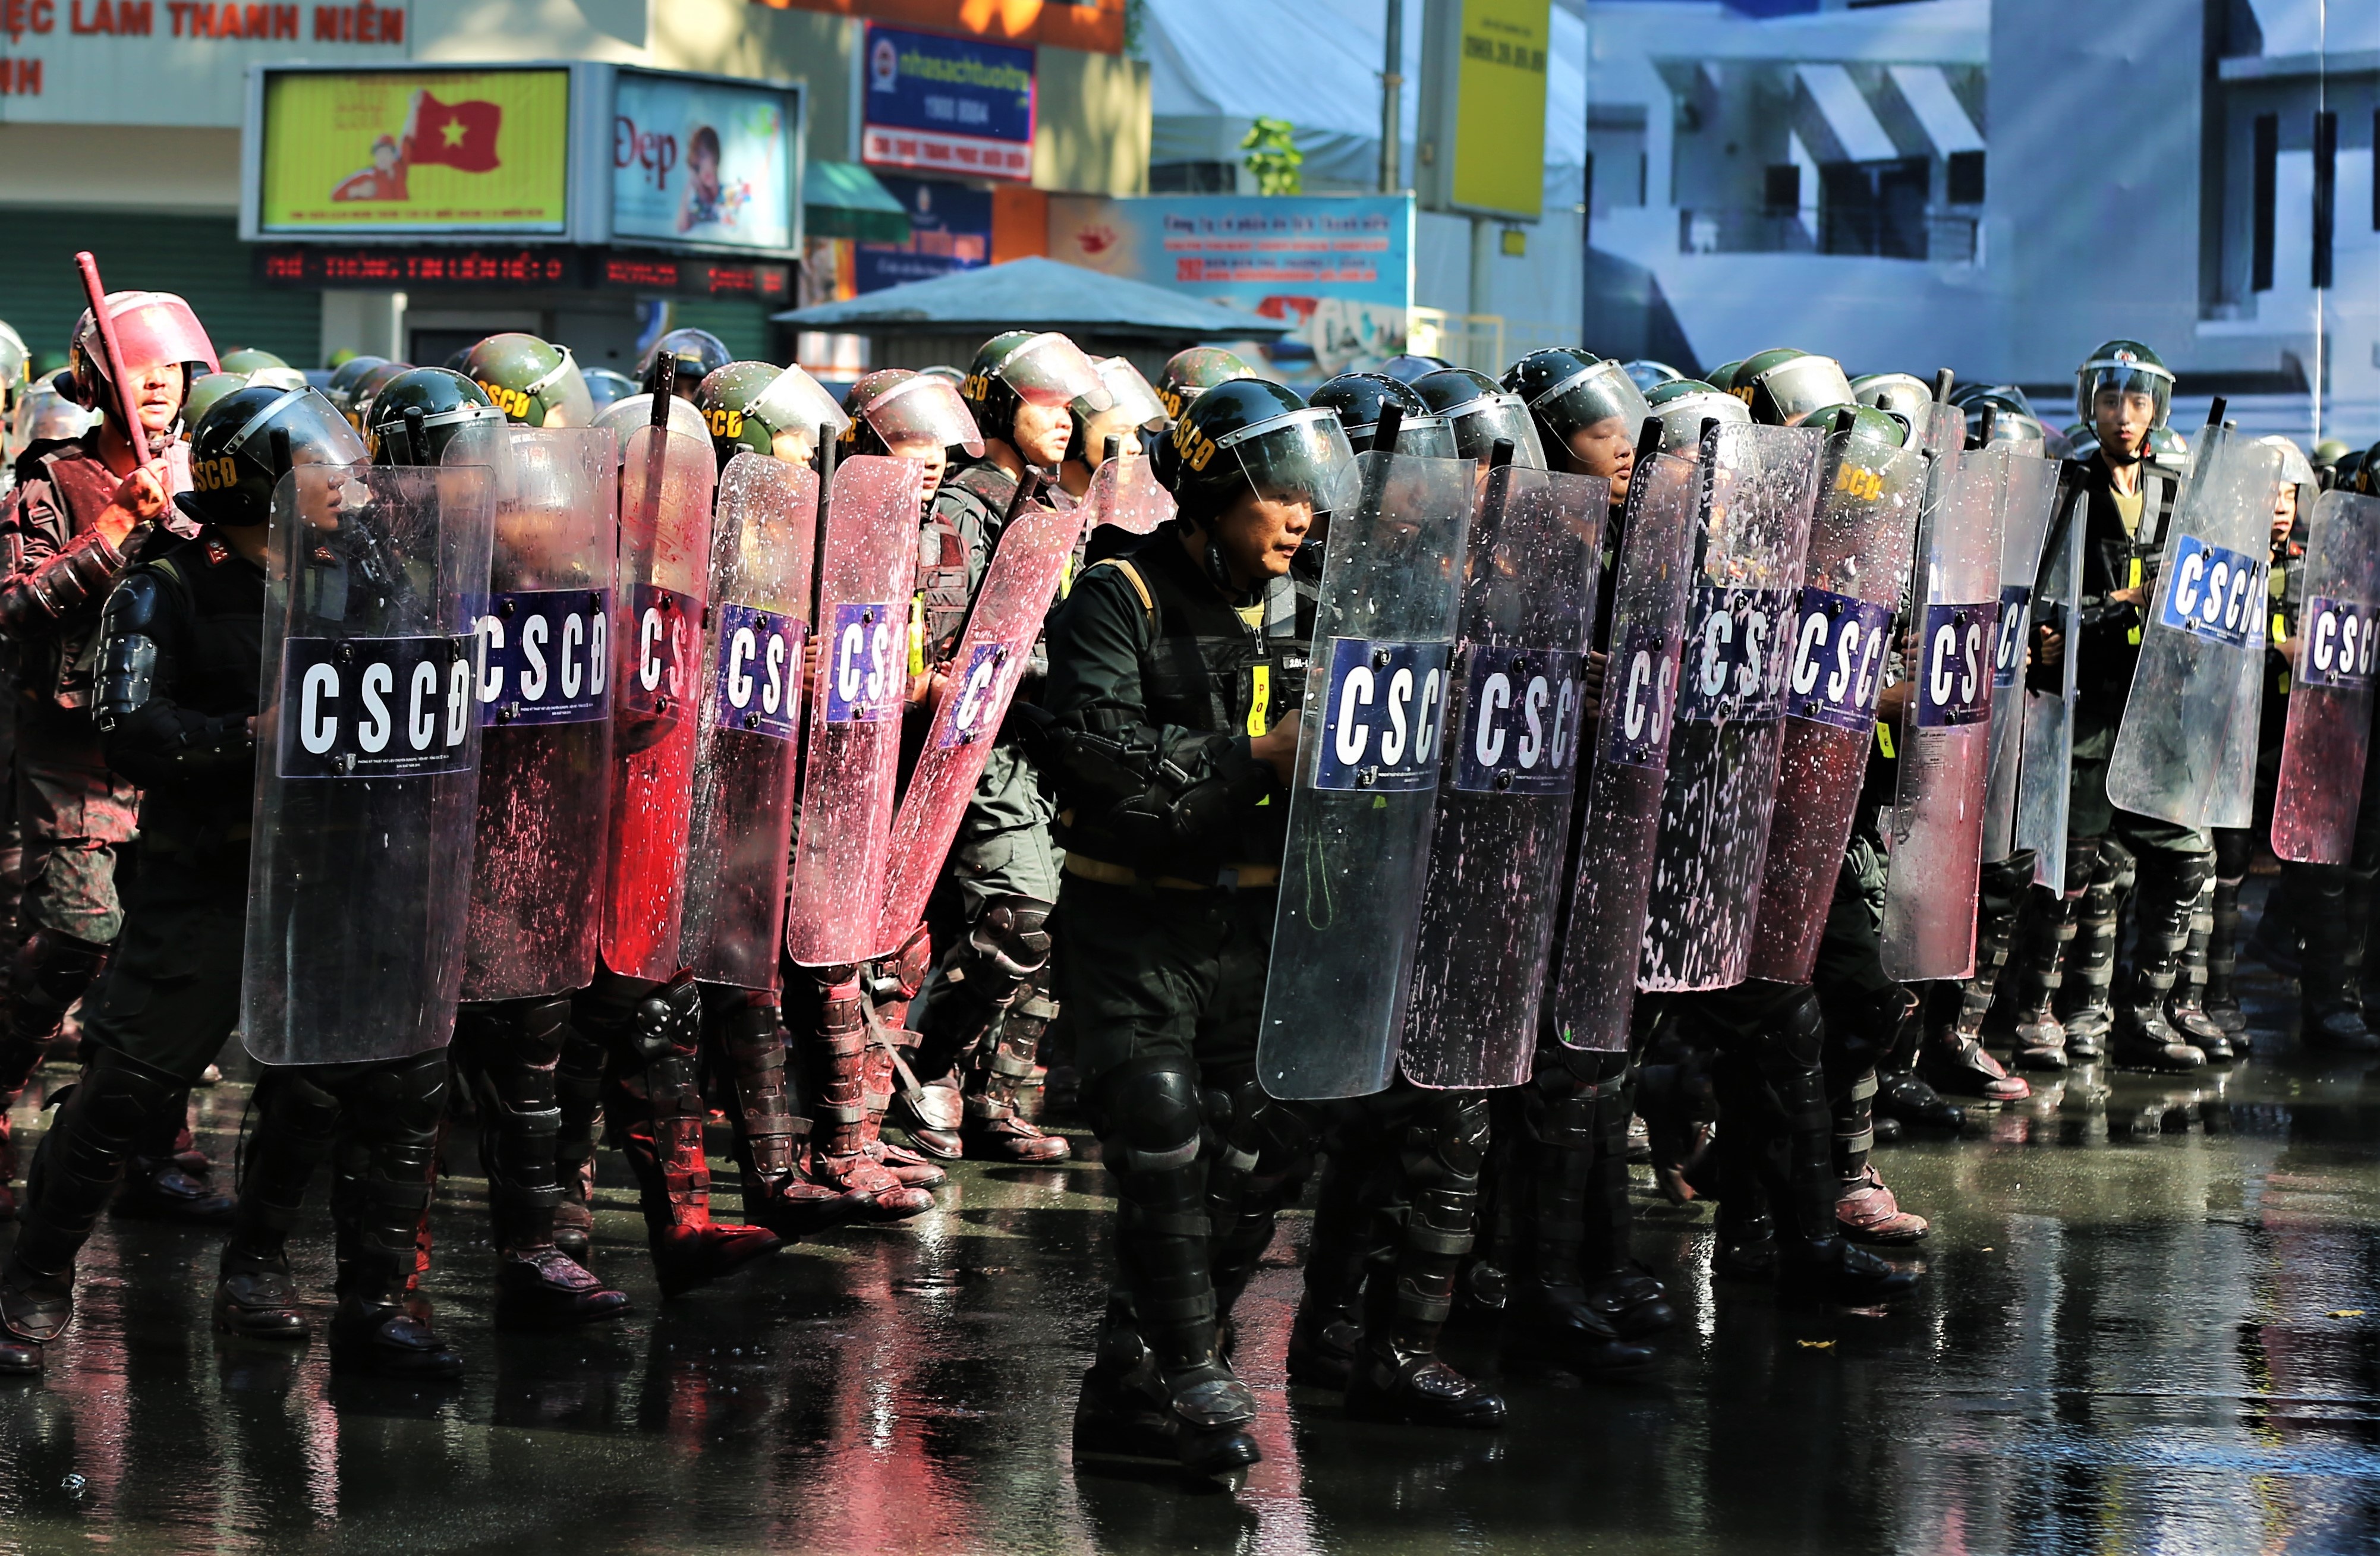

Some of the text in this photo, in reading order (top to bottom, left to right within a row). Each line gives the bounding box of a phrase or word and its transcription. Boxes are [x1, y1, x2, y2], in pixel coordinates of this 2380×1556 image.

[166, 2, 299, 39] THANH
[314, 0, 404, 43] NIÊN
[613, 116, 678, 191] Đẹp
[193, 456, 237, 493] SCĐ
[474, 611, 607, 704] CSCĐ
[727, 626, 802, 720] CSC
[838, 622, 905, 703] CSC
[1701, 610, 1790, 697] CSC
[1791, 611, 1883, 708] CSC
[1929, 620, 1995, 707] CSC
[2313, 610, 2375, 675] CSC
[300, 658, 470, 754] CSCĐ
[956, 656, 1016, 731] CS
[1335, 666, 1442, 766] CSC
[1475, 672, 1574, 769] CSC
[1624, 650, 1671, 745] CS
